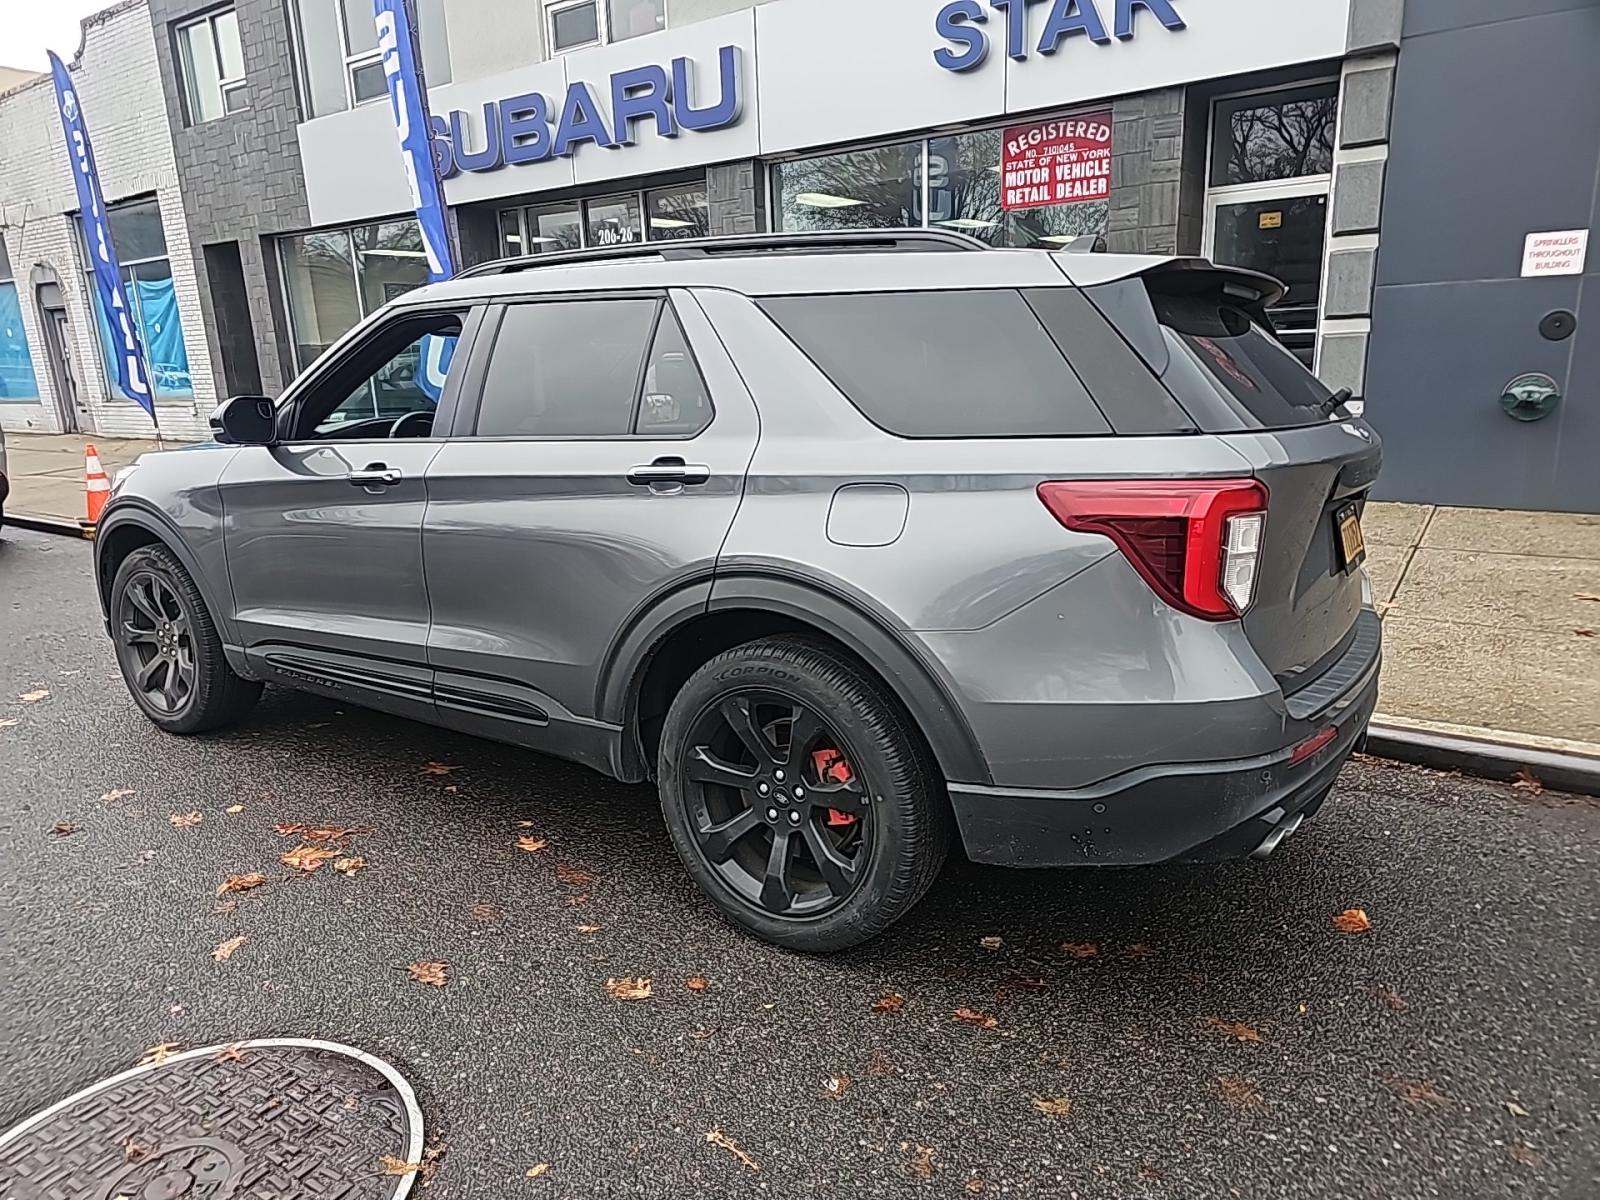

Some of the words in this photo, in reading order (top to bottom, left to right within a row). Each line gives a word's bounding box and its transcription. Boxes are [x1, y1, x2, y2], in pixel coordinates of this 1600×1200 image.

[933, 0, 1187, 72] STAR
[431, 45, 742, 178] SUBARU
[1007, 121, 1110, 157] REGISTERED
[1005, 158, 1035, 170] STATE
[1039, 156, 1052, 166] OF
[1056, 152, 1078, 164] NEW
[1082, 148, 1110, 160] YORK
[1005, 167, 1049, 188] MOTOR
[1056, 158, 1110, 181] VEHICLE
[1007, 184, 1051, 205] RETAIL
[1056, 178, 1107, 199] DEALER
[598, 226, 633, 245] 206-26
[1529, 248, 1581, 258] THROUGHOUT
